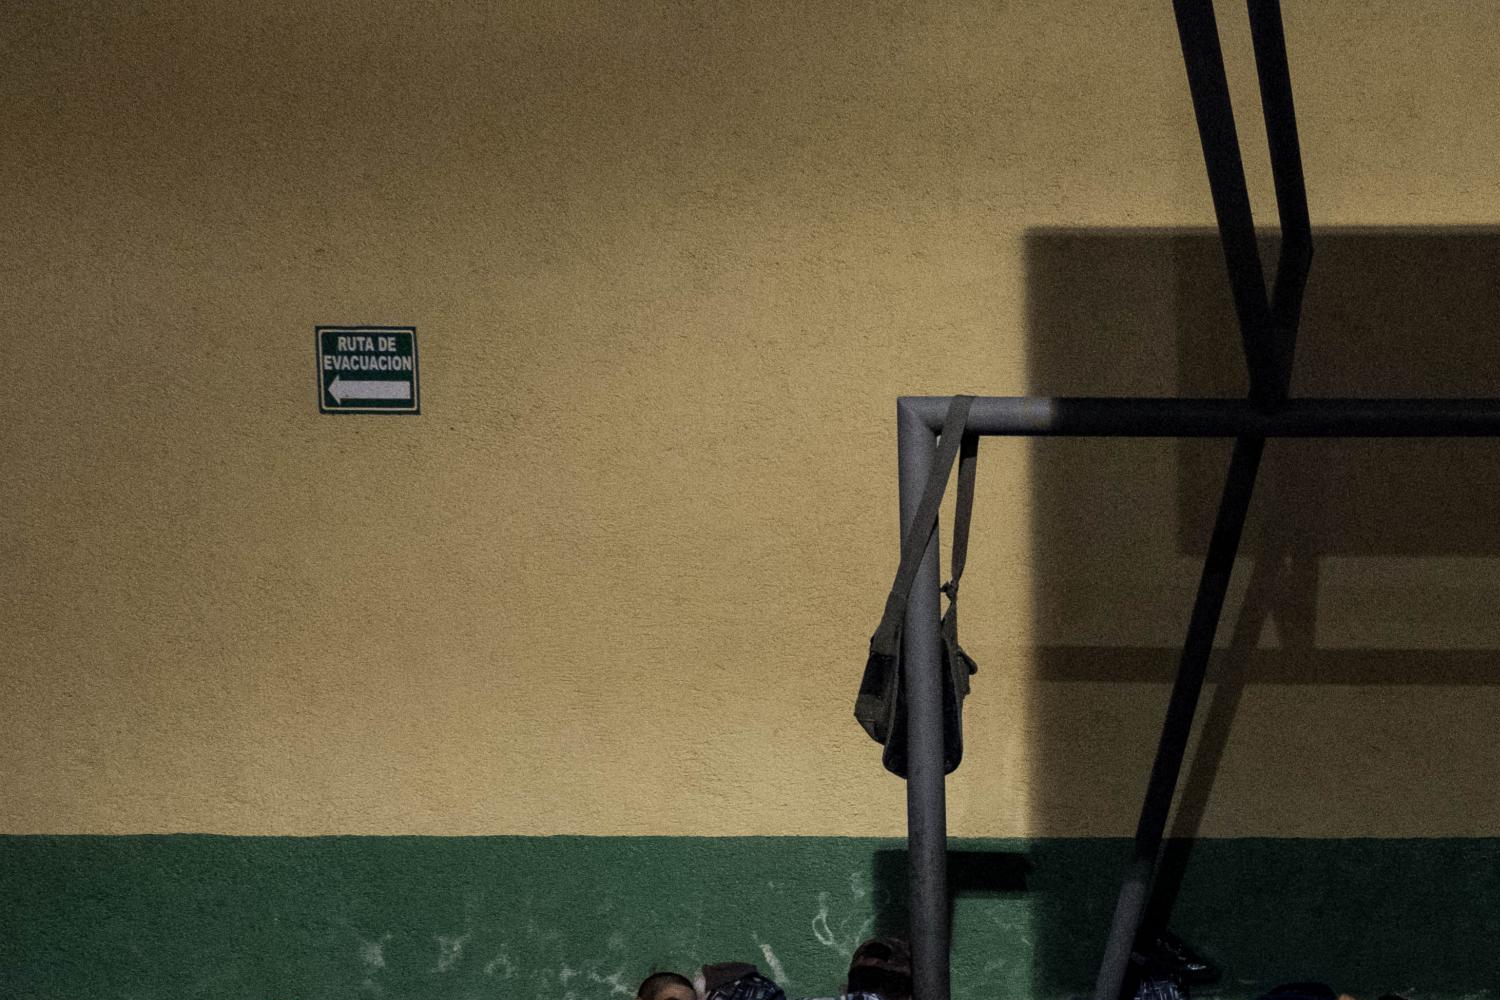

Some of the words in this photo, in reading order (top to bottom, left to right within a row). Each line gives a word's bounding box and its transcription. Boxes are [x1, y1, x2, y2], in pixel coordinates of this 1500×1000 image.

[337, 336, 375, 352] RUTA
[378, 336, 397, 352] DE
[323, 355, 412, 371] EVACUACION
